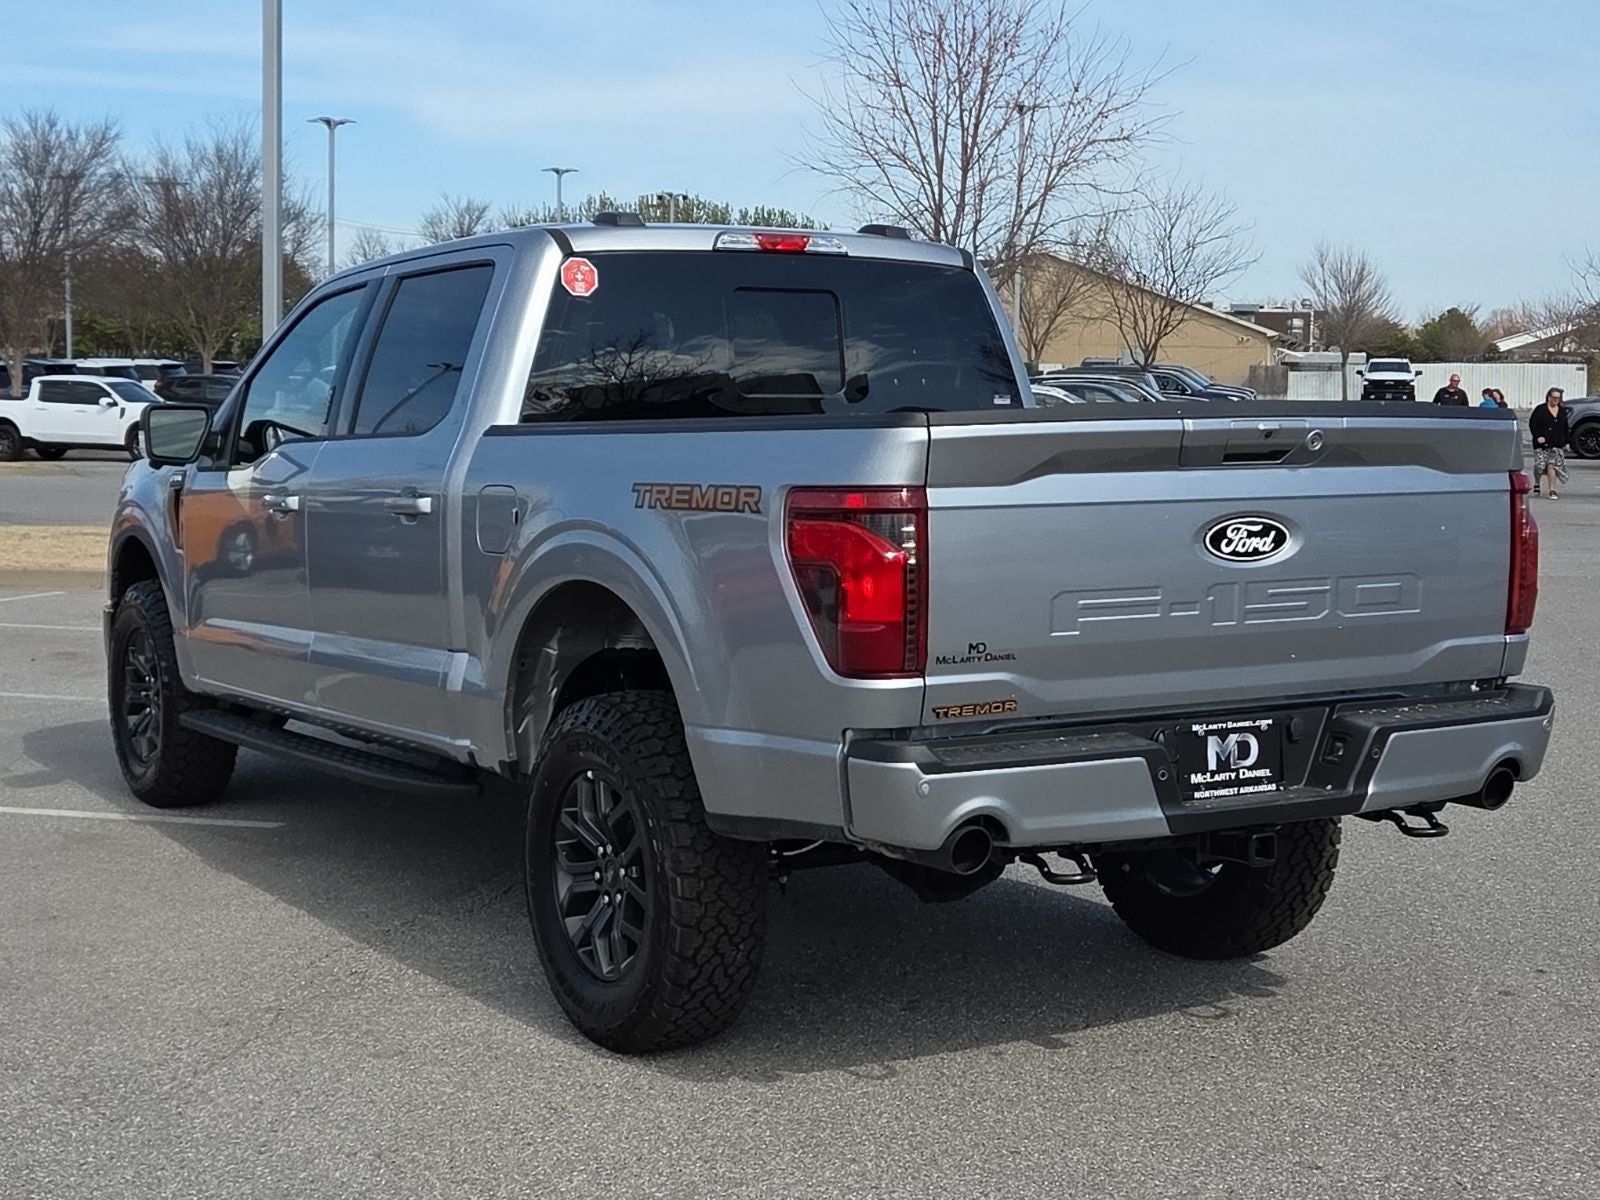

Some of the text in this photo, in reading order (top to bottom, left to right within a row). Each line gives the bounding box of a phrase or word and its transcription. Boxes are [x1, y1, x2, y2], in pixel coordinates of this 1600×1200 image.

[632, 483, 762, 514] TREMOR
[1220, 523, 1275, 553] Ford
[1050, 572, 1422, 637] F-150
[968, 642, 986, 654] MD
[932, 700, 1017, 719] TREMOR
[1207, 732, 1259, 771] MD
[1194, 783, 1277, 799] NORTHWEST ARKANSAS
